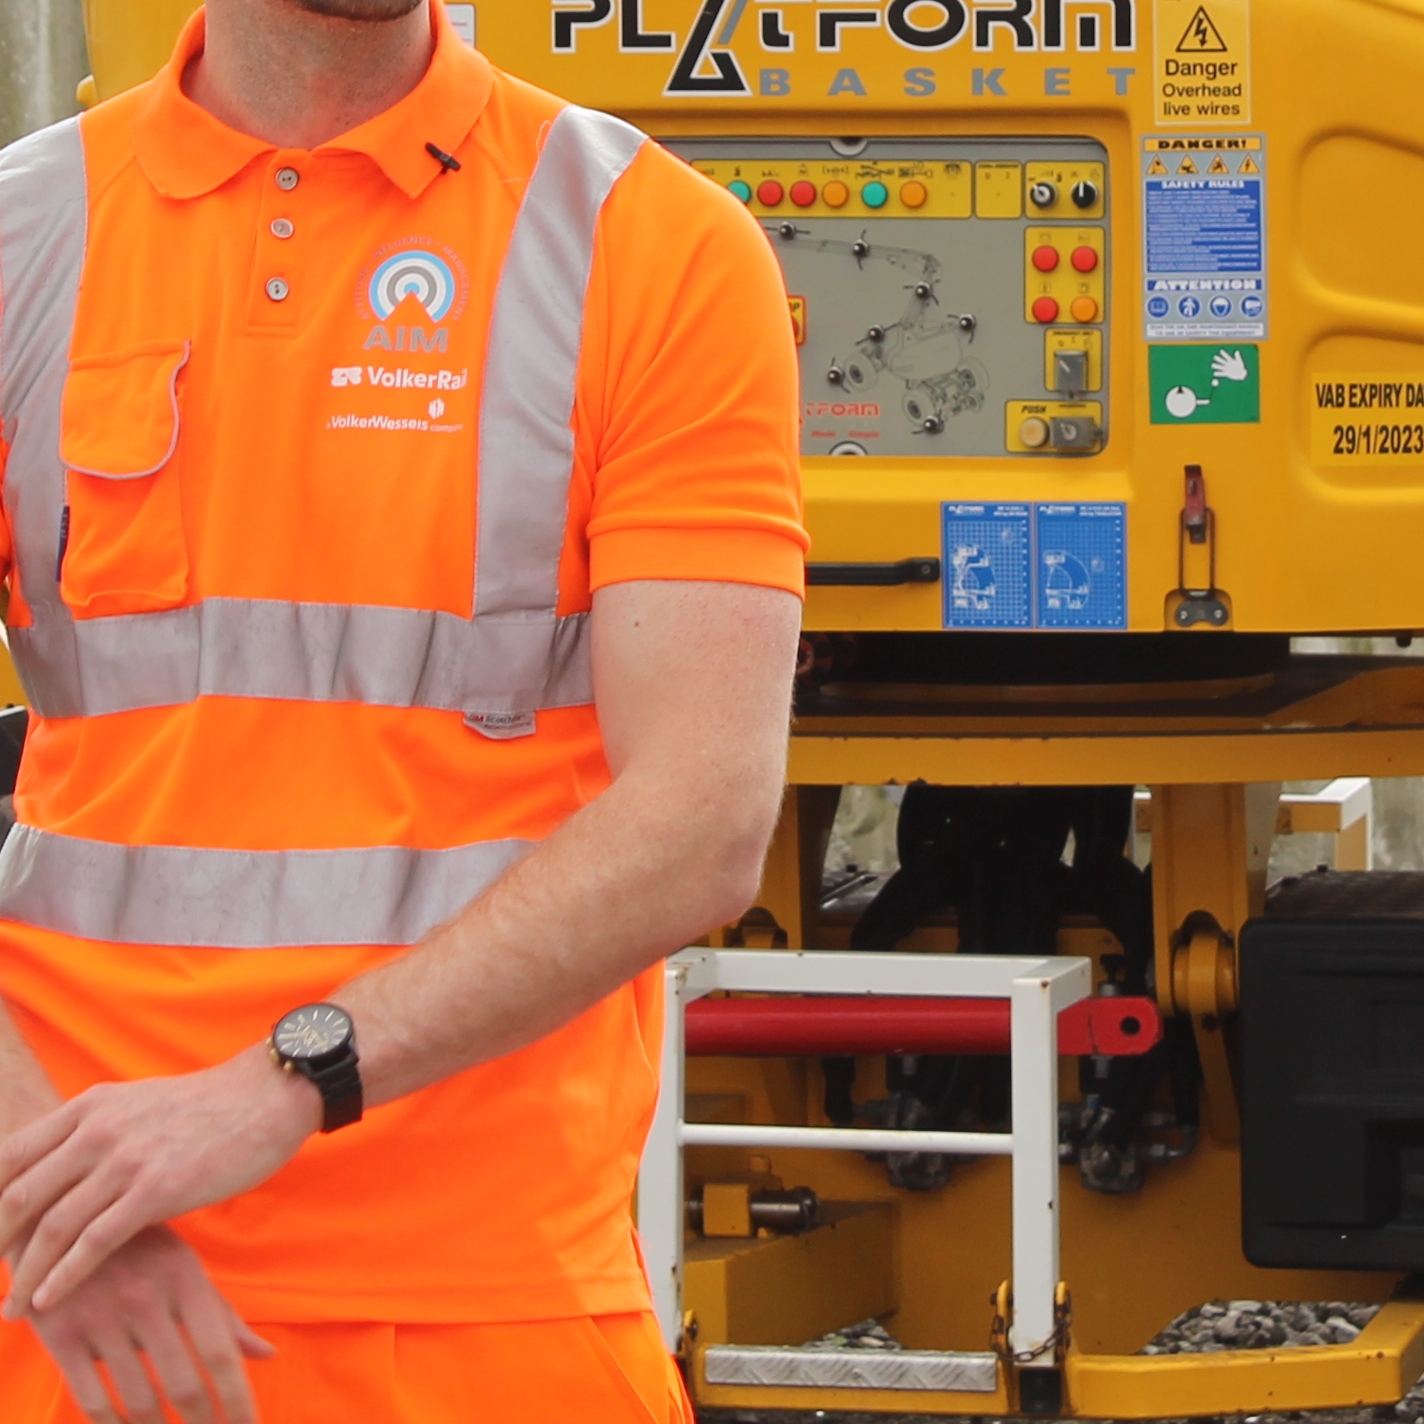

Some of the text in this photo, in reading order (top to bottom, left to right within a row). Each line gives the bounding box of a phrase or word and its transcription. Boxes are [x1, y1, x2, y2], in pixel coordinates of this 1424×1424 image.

[1165, 59, 1238, 81] Danger
[758, 67, 1136, 97] BASKET
[1162, 82, 1242, 97] Overhead
[1164, 102, 1241, 115] live wires
[1158, 139, 1247, 149] DANGER!
[1154, 279, 1256, 291] ATTENTION
[362, 325, 450, 353] AIM
[367, 365, 468, 390] VolkerRail
[1315, 383, 1345, 408] VAB
[1348, 383, 1403, 408] EXPIRY
[804, 402, 880, 417] TFORM
[1020, 404, 1047, 415] PUSH
[1332, 424, 1424, 455] 29/1/2023
